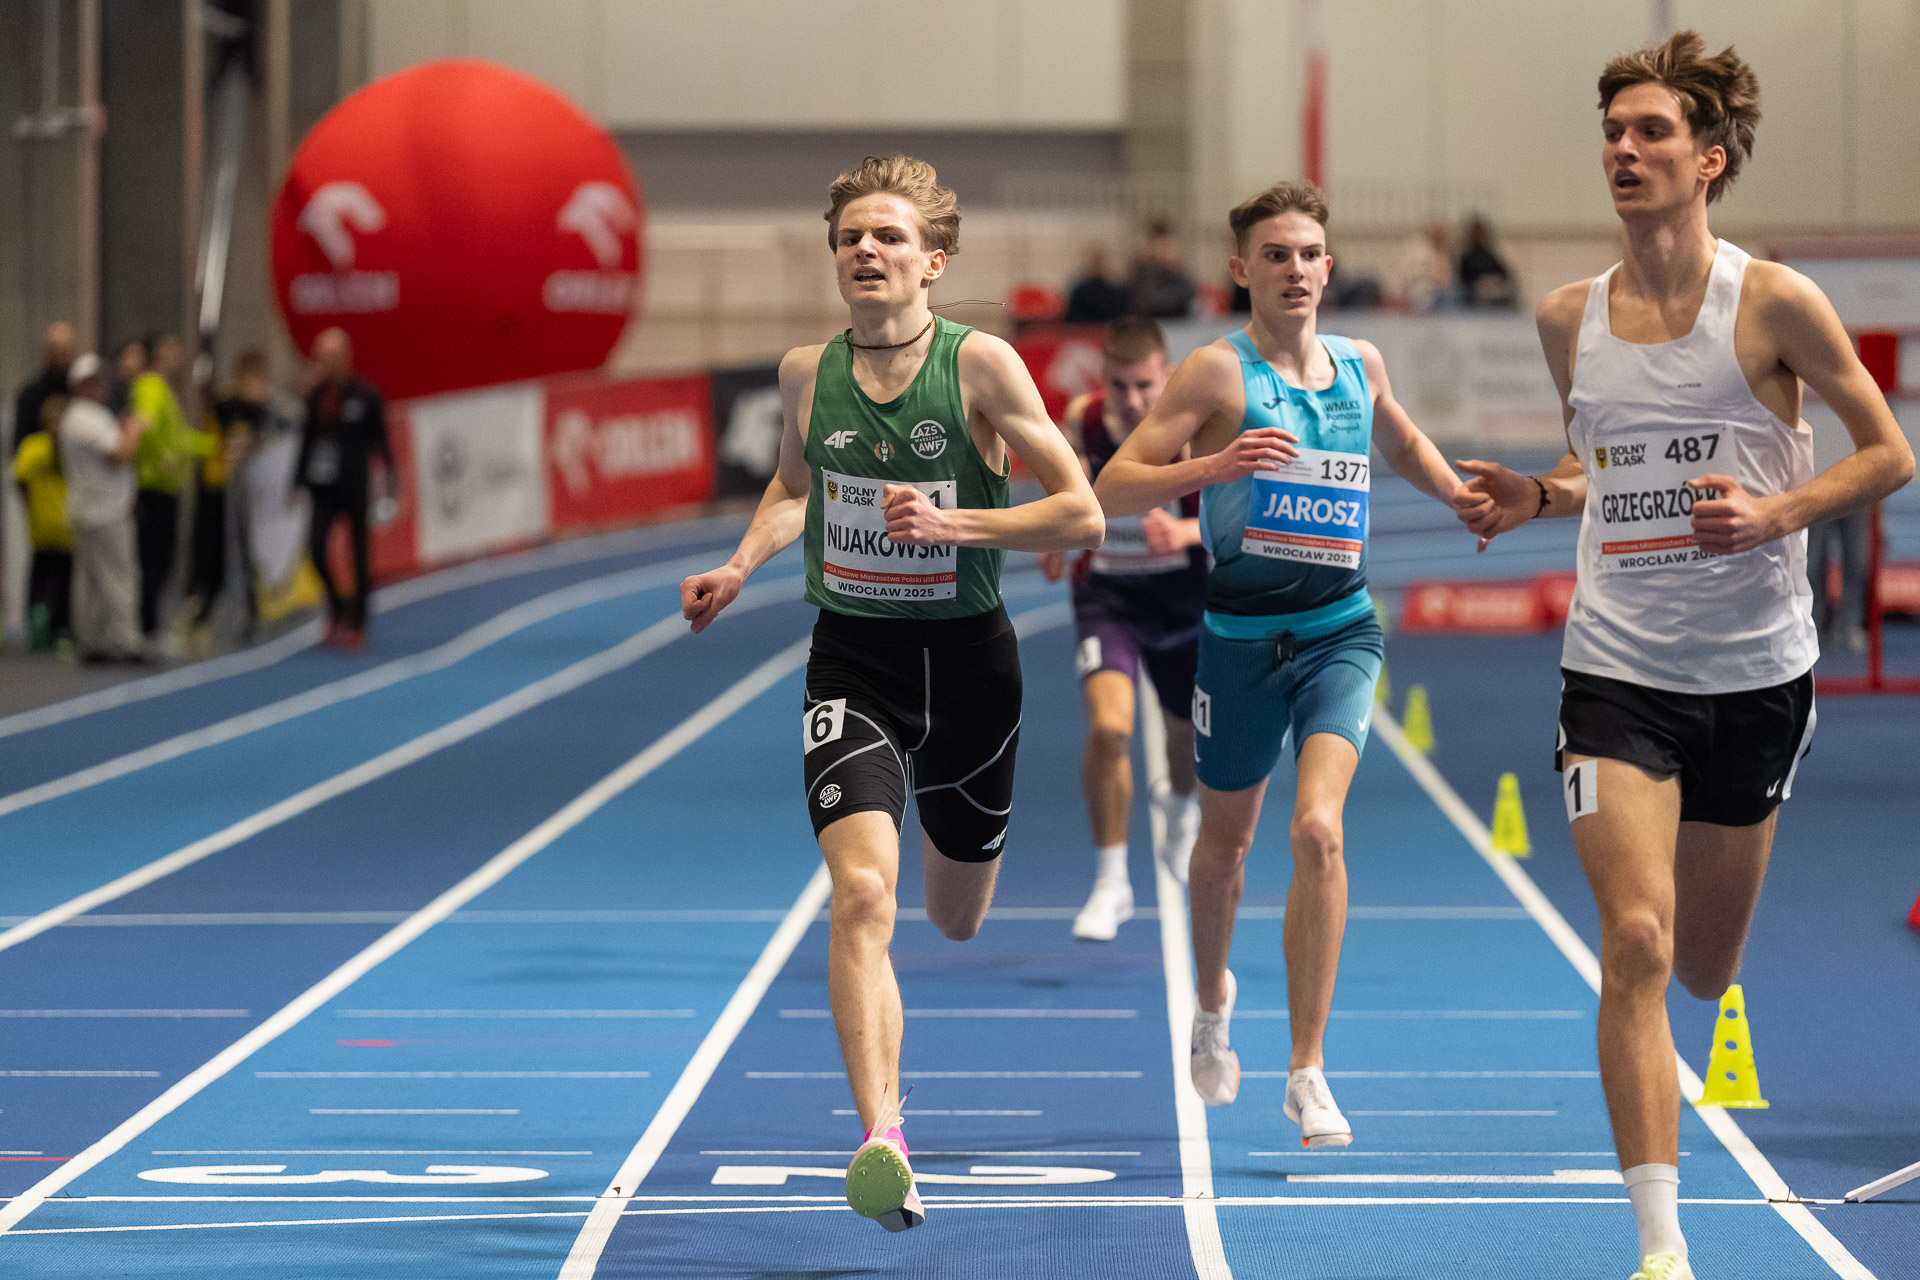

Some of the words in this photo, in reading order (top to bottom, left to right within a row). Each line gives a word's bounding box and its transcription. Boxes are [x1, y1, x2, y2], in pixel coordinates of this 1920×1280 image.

[1324, 399, 1360, 412] WMLKS
[824, 430, 858, 449] 4F
[916, 425, 938, 437] AZS
[918, 440, 942, 453] AWF
[1610, 443, 1647, 456] DOLNY
[1665, 433, 1719, 464] 487
[1611, 454, 1646, 468] ŚLĄSK
[1320, 459, 1368, 484] 1377
[841, 484, 877, 498] DOLNY
[841, 494, 875, 508] ŚLĄSK
[1262, 493, 1360, 528] JAROSZ
[1263, 545, 1325, 560] WROCŁAW
[1327, 552, 1353, 564] 2025
[1618, 552, 1688, 569] WROCŁAW
[1691, 549, 1721, 561] 20
[837, 568, 859, 579] Halowe
[860, 573, 900, 582] Mistrzostwa
[901, 575, 922, 583] Polski
[837, 580, 902, 597] WROCŁAW
[904, 587, 935, 598] 2025
[810, 704, 834, 744] 6
[1568, 767, 1582, 813] 1
